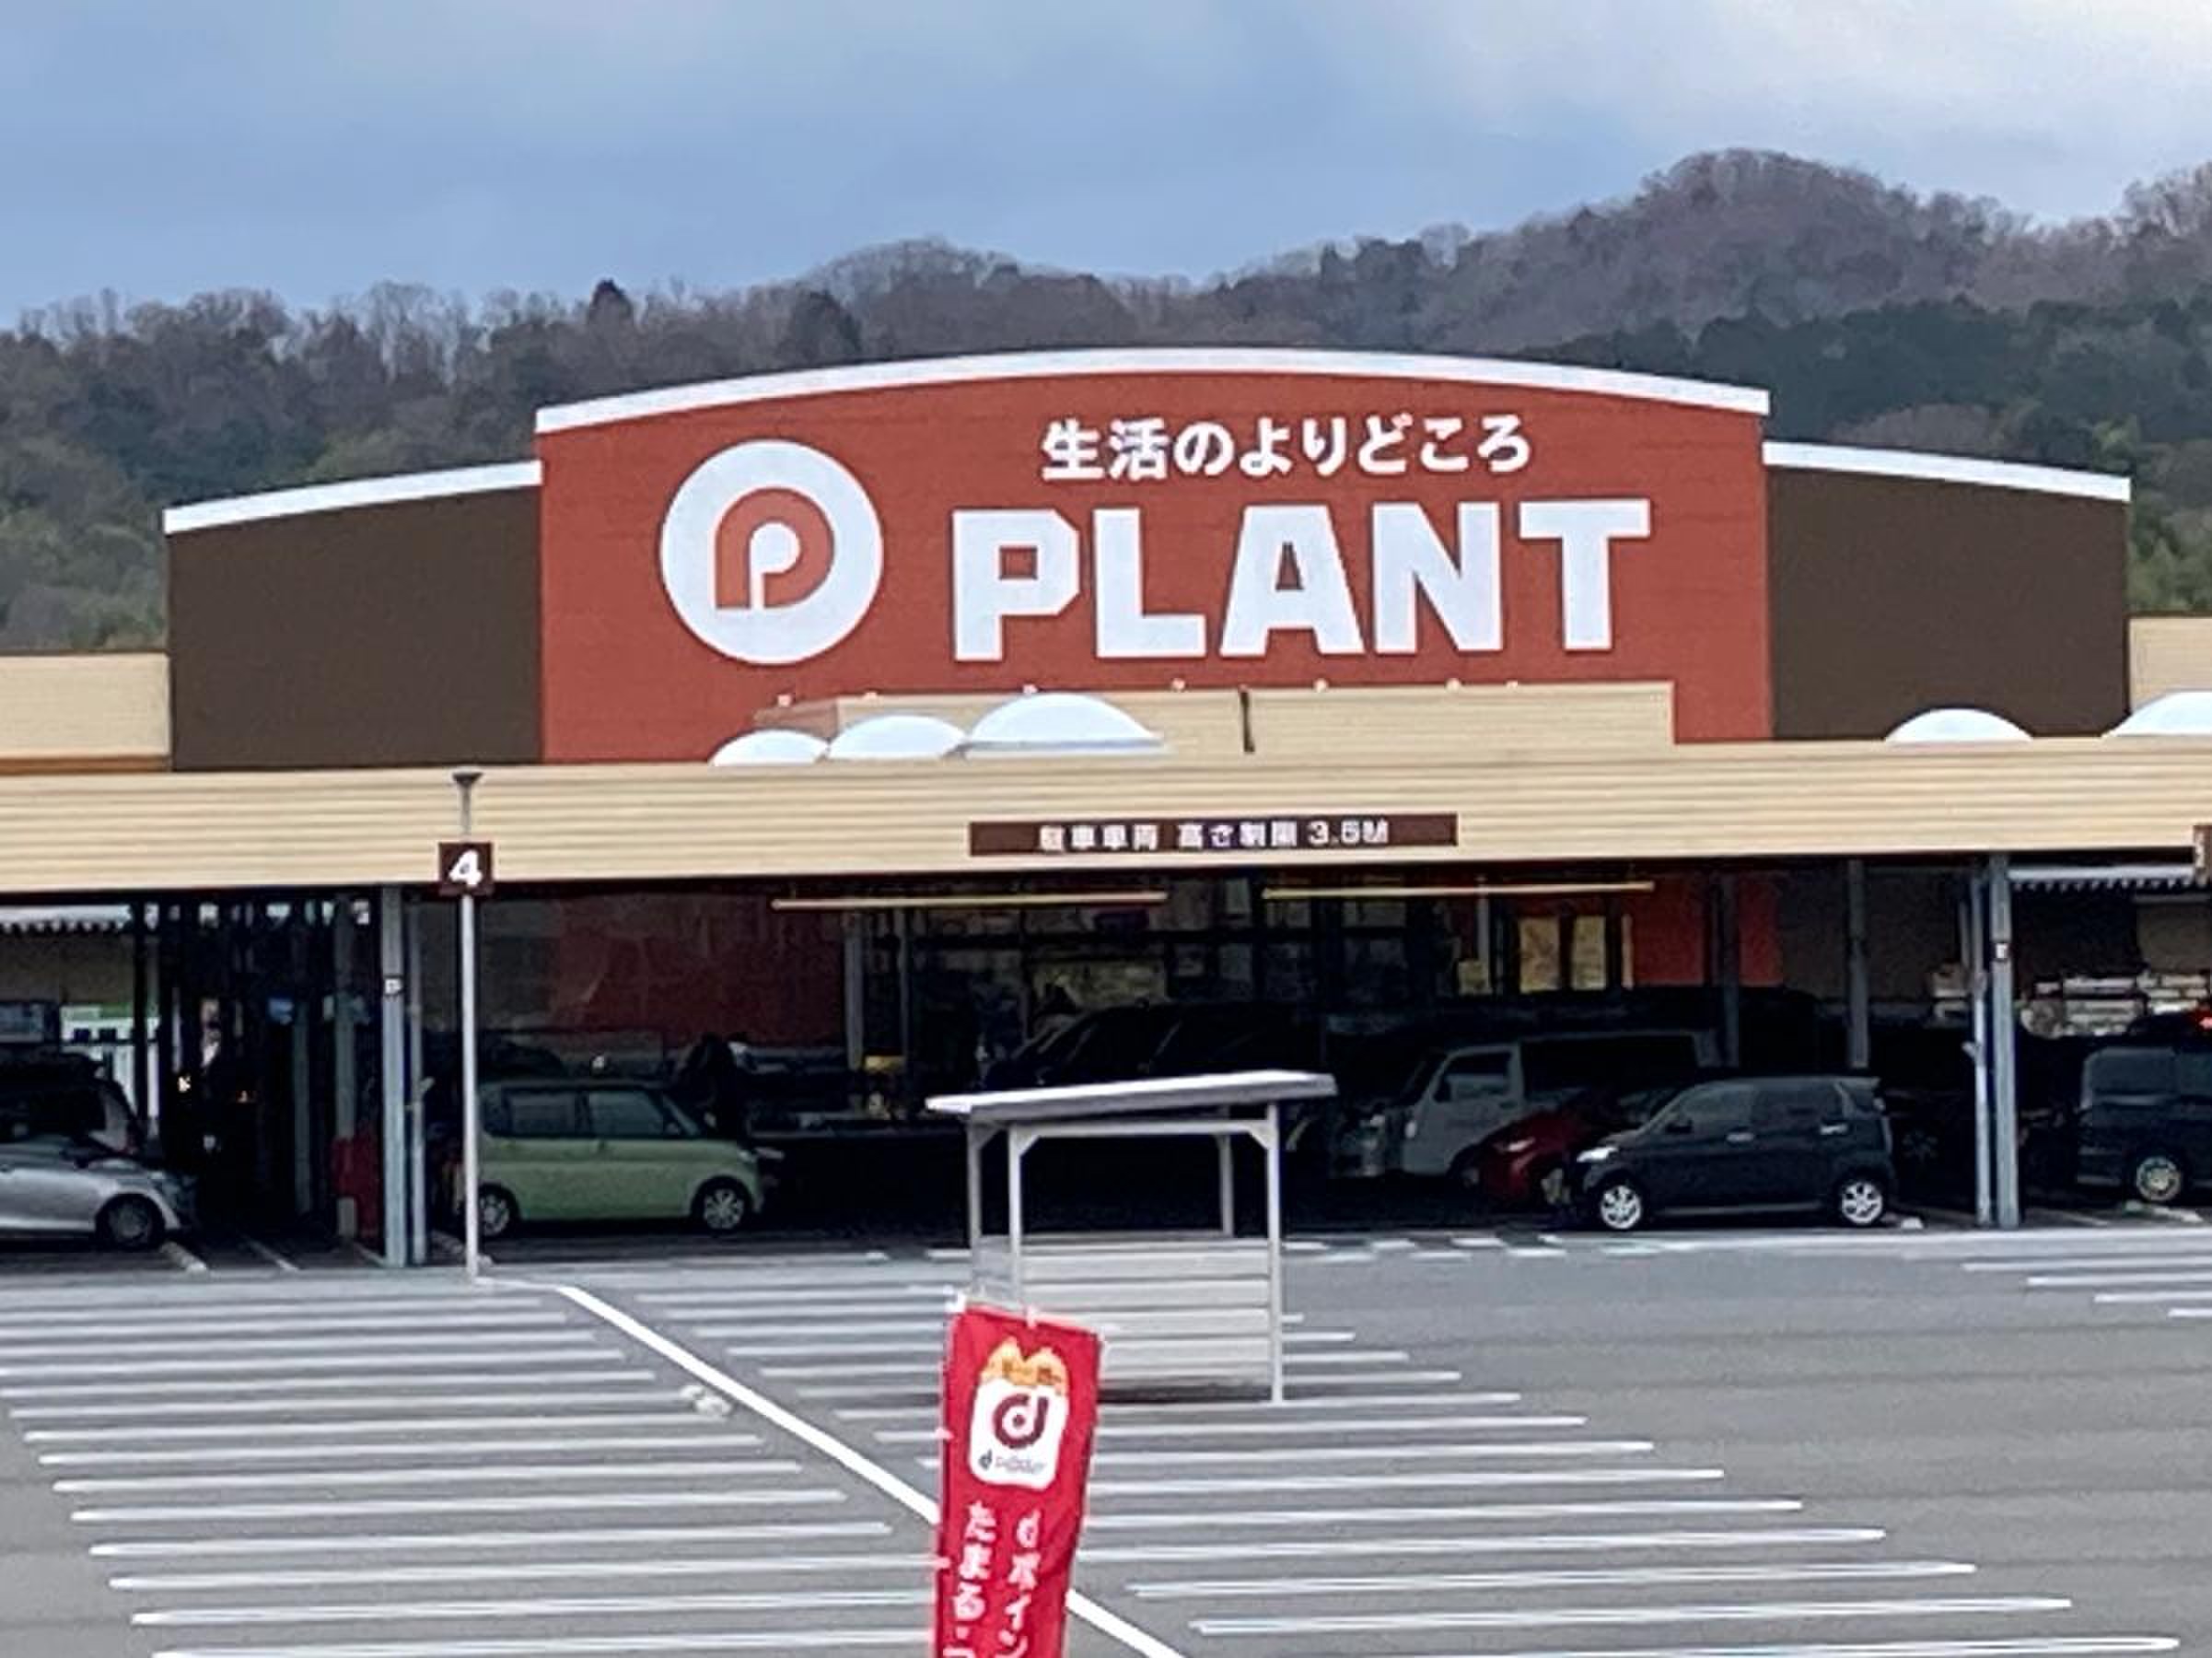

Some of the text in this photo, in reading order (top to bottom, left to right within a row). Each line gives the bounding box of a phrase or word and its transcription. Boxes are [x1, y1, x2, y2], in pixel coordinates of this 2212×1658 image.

[1041, 413, 1531, 482] 生活のよりどころ
[952, 497, 1651, 661] PLANT
[448, 849, 483, 887] 4
